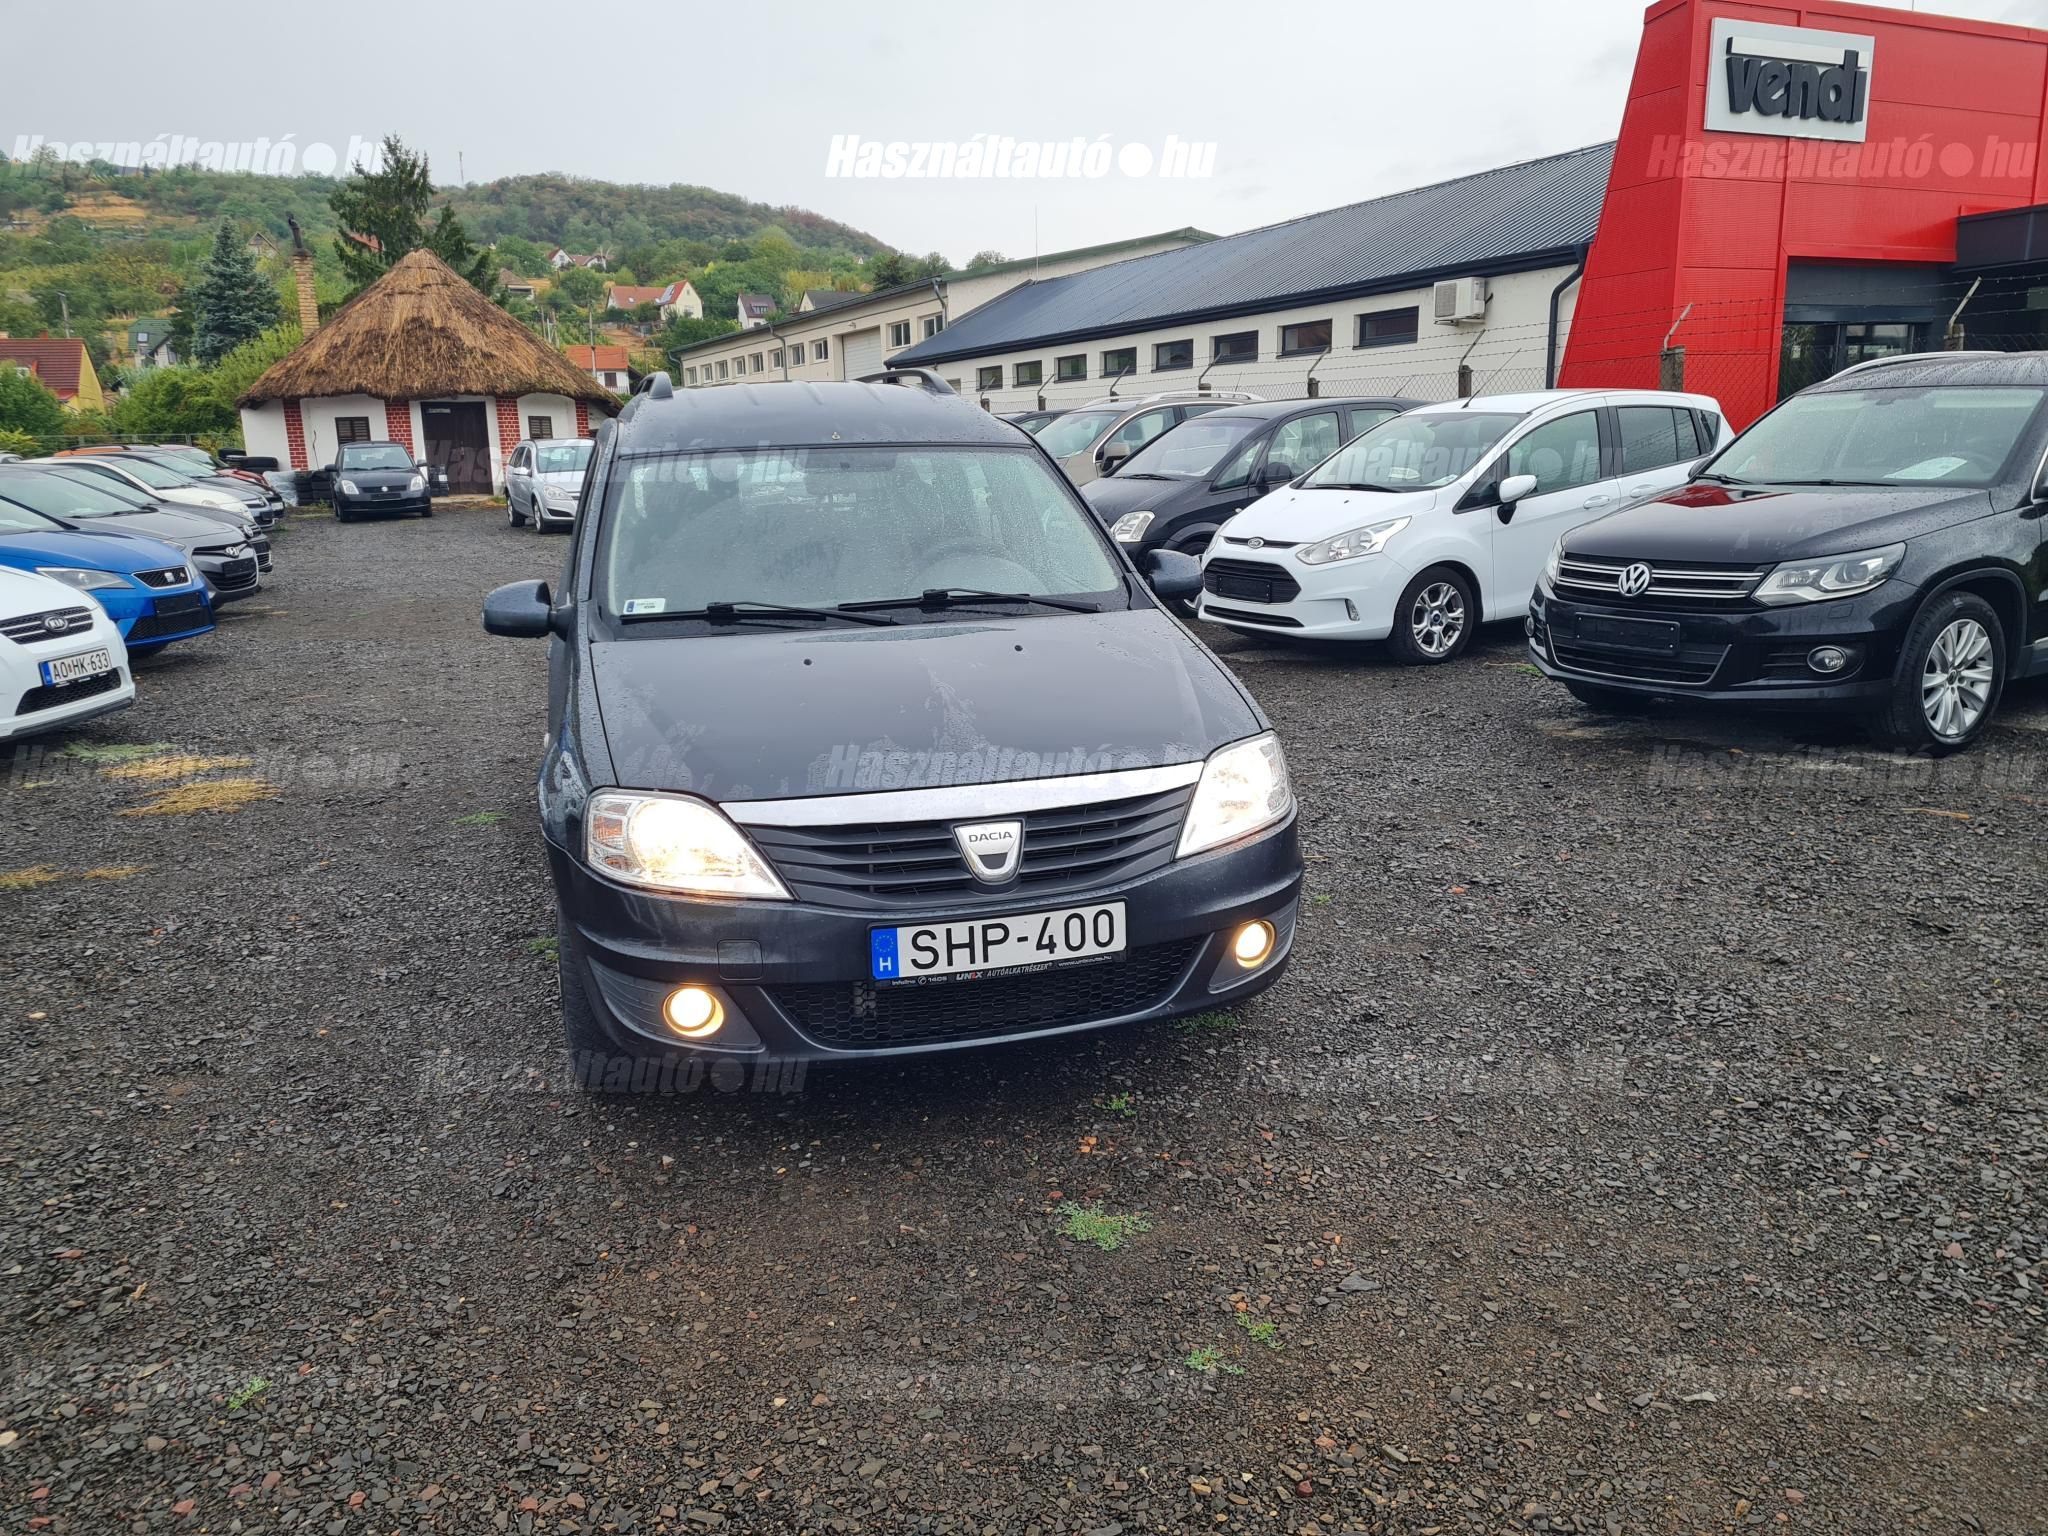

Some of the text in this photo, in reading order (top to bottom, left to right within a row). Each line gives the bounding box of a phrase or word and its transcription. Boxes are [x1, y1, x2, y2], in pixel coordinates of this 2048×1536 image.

[1726, 47, 1867, 123] vendi
[47, 618, 66, 629] KIA
[968, 831, 1014, 843] DACIA
[910, 908, 1115, 970] SHP-400
[879, 957, 892, 972] H
[956, 971, 983, 981] UNIX
